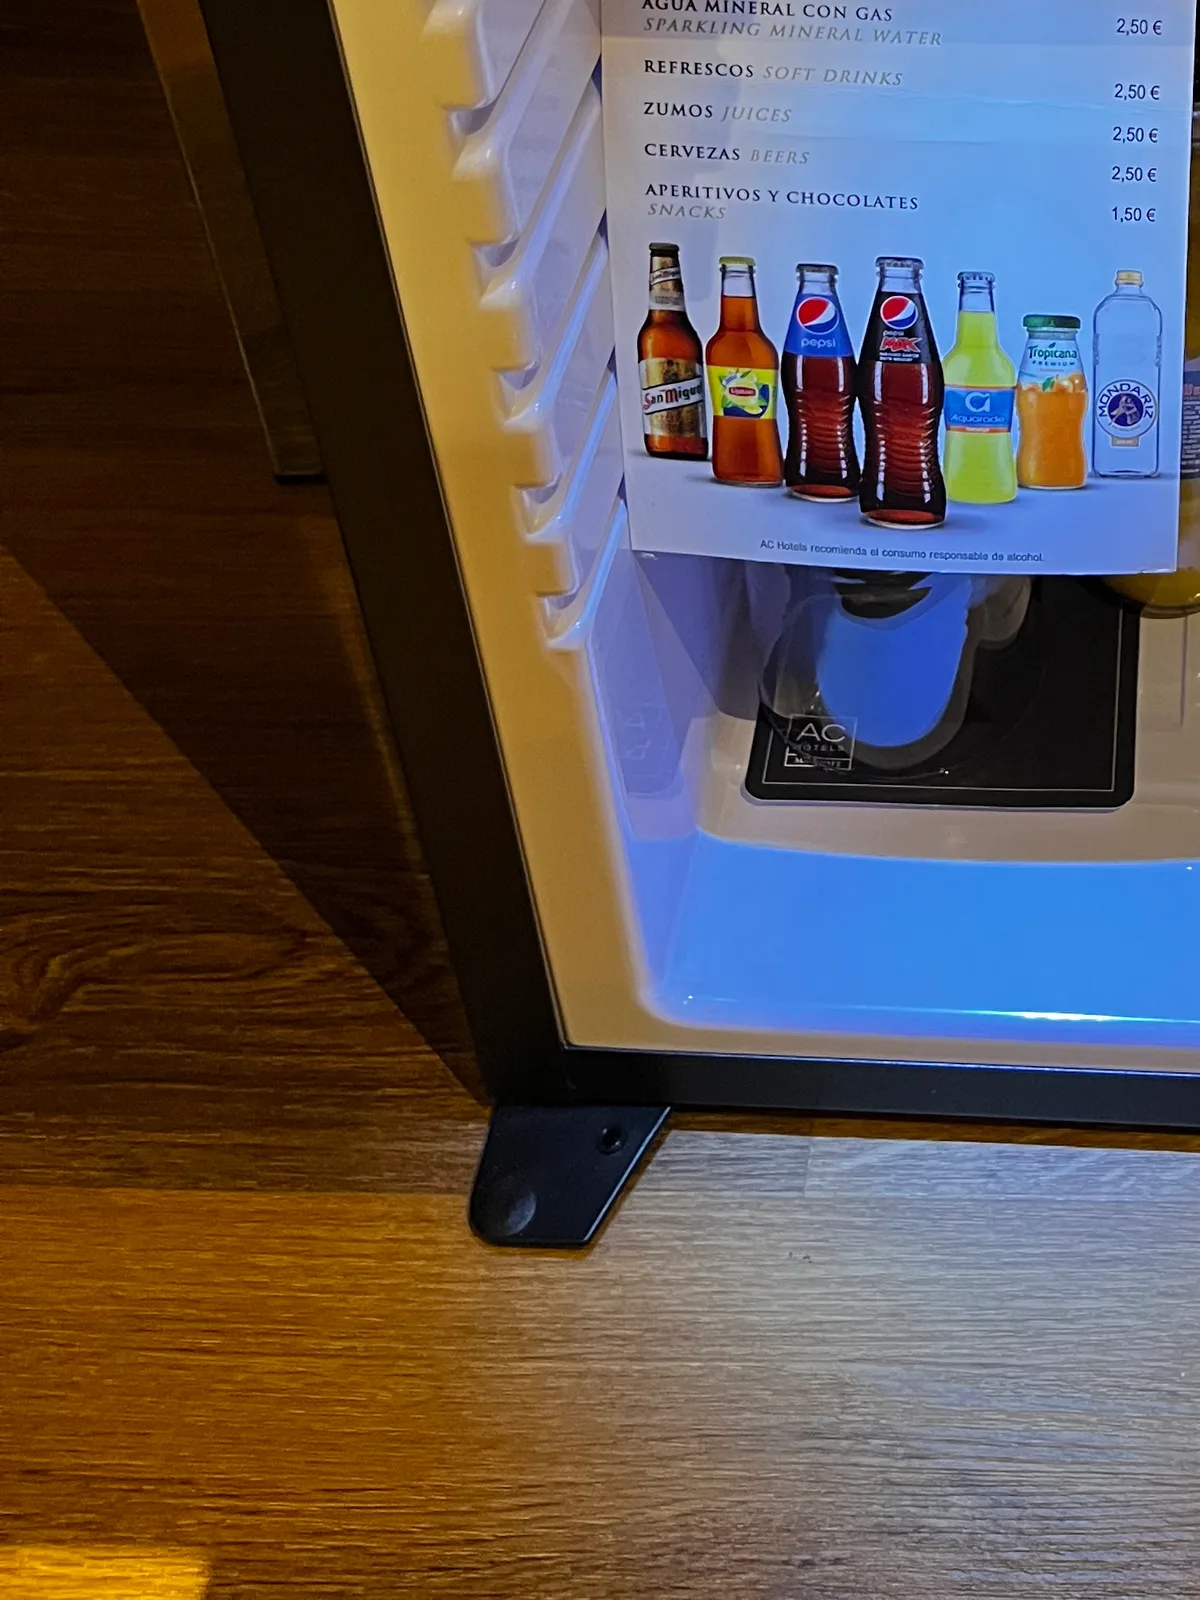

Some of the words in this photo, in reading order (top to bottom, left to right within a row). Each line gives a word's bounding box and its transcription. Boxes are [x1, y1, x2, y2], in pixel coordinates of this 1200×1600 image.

[644, 16, 760, 38] SPARKLING
[769, 22, 864, 43] MINERAL
[872, 27, 943, 46] WATER
[802, 2, 848, 21] CON
[855, 5, 893, 22] GAS
[1116, 18, 1147, 38] 2,50
[1152, 20, 1162, 36] €
[643, 59, 754, 79] REFRESCOS
[762, 64, 816, 83] SOFT
[822, 67, 904, 87] DRINKS
[1114, 82, 1145, 102] 2,50
[1149, 85, 1159, 100] €
[643, 101, 714, 120] ZUMOS
[719, 104, 792, 124] JUICES
[1112, 125, 1143, 145] 2,50
[1148, 128, 1158, 143] €
[644, 142, 741, 162] CERVEZAS
[749, 147, 810, 166] BEERS
[1111, 165, 1142, 184] 2,50
[1146, 167, 1157, 182] €
[645, 183, 761, 204] APERITIVOS
[767, 189, 780, 204] Y
[786, 190, 919, 211] CHOCOLATES
[1111, 205, 1141, 224] 1,50
[1145, 207, 1156, 223] €
[647, 203, 726, 221] SNACKS
[801, 336, 836, 350] pepsi
[1027, 344, 1078, 360] Tropicana
[1098, 382, 1155, 420] MONDARIZ
[949, 412, 1006, 424] Aquarade
[760, 538, 775, 551] AC
[776, 540, 808, 553] Hotels
[810, 544, 868, 557] recomienda
[870, 546, 880, 557] el
[881, 548, 927, 560] consumo
[929, 549, 989, 563] responsable
[991, 551, 1005, 562] de
[1006, 551, 1045, 563] alcohol.
[795, 722, 847, 743] AC
[794, 744, 845, 752] OTELS
